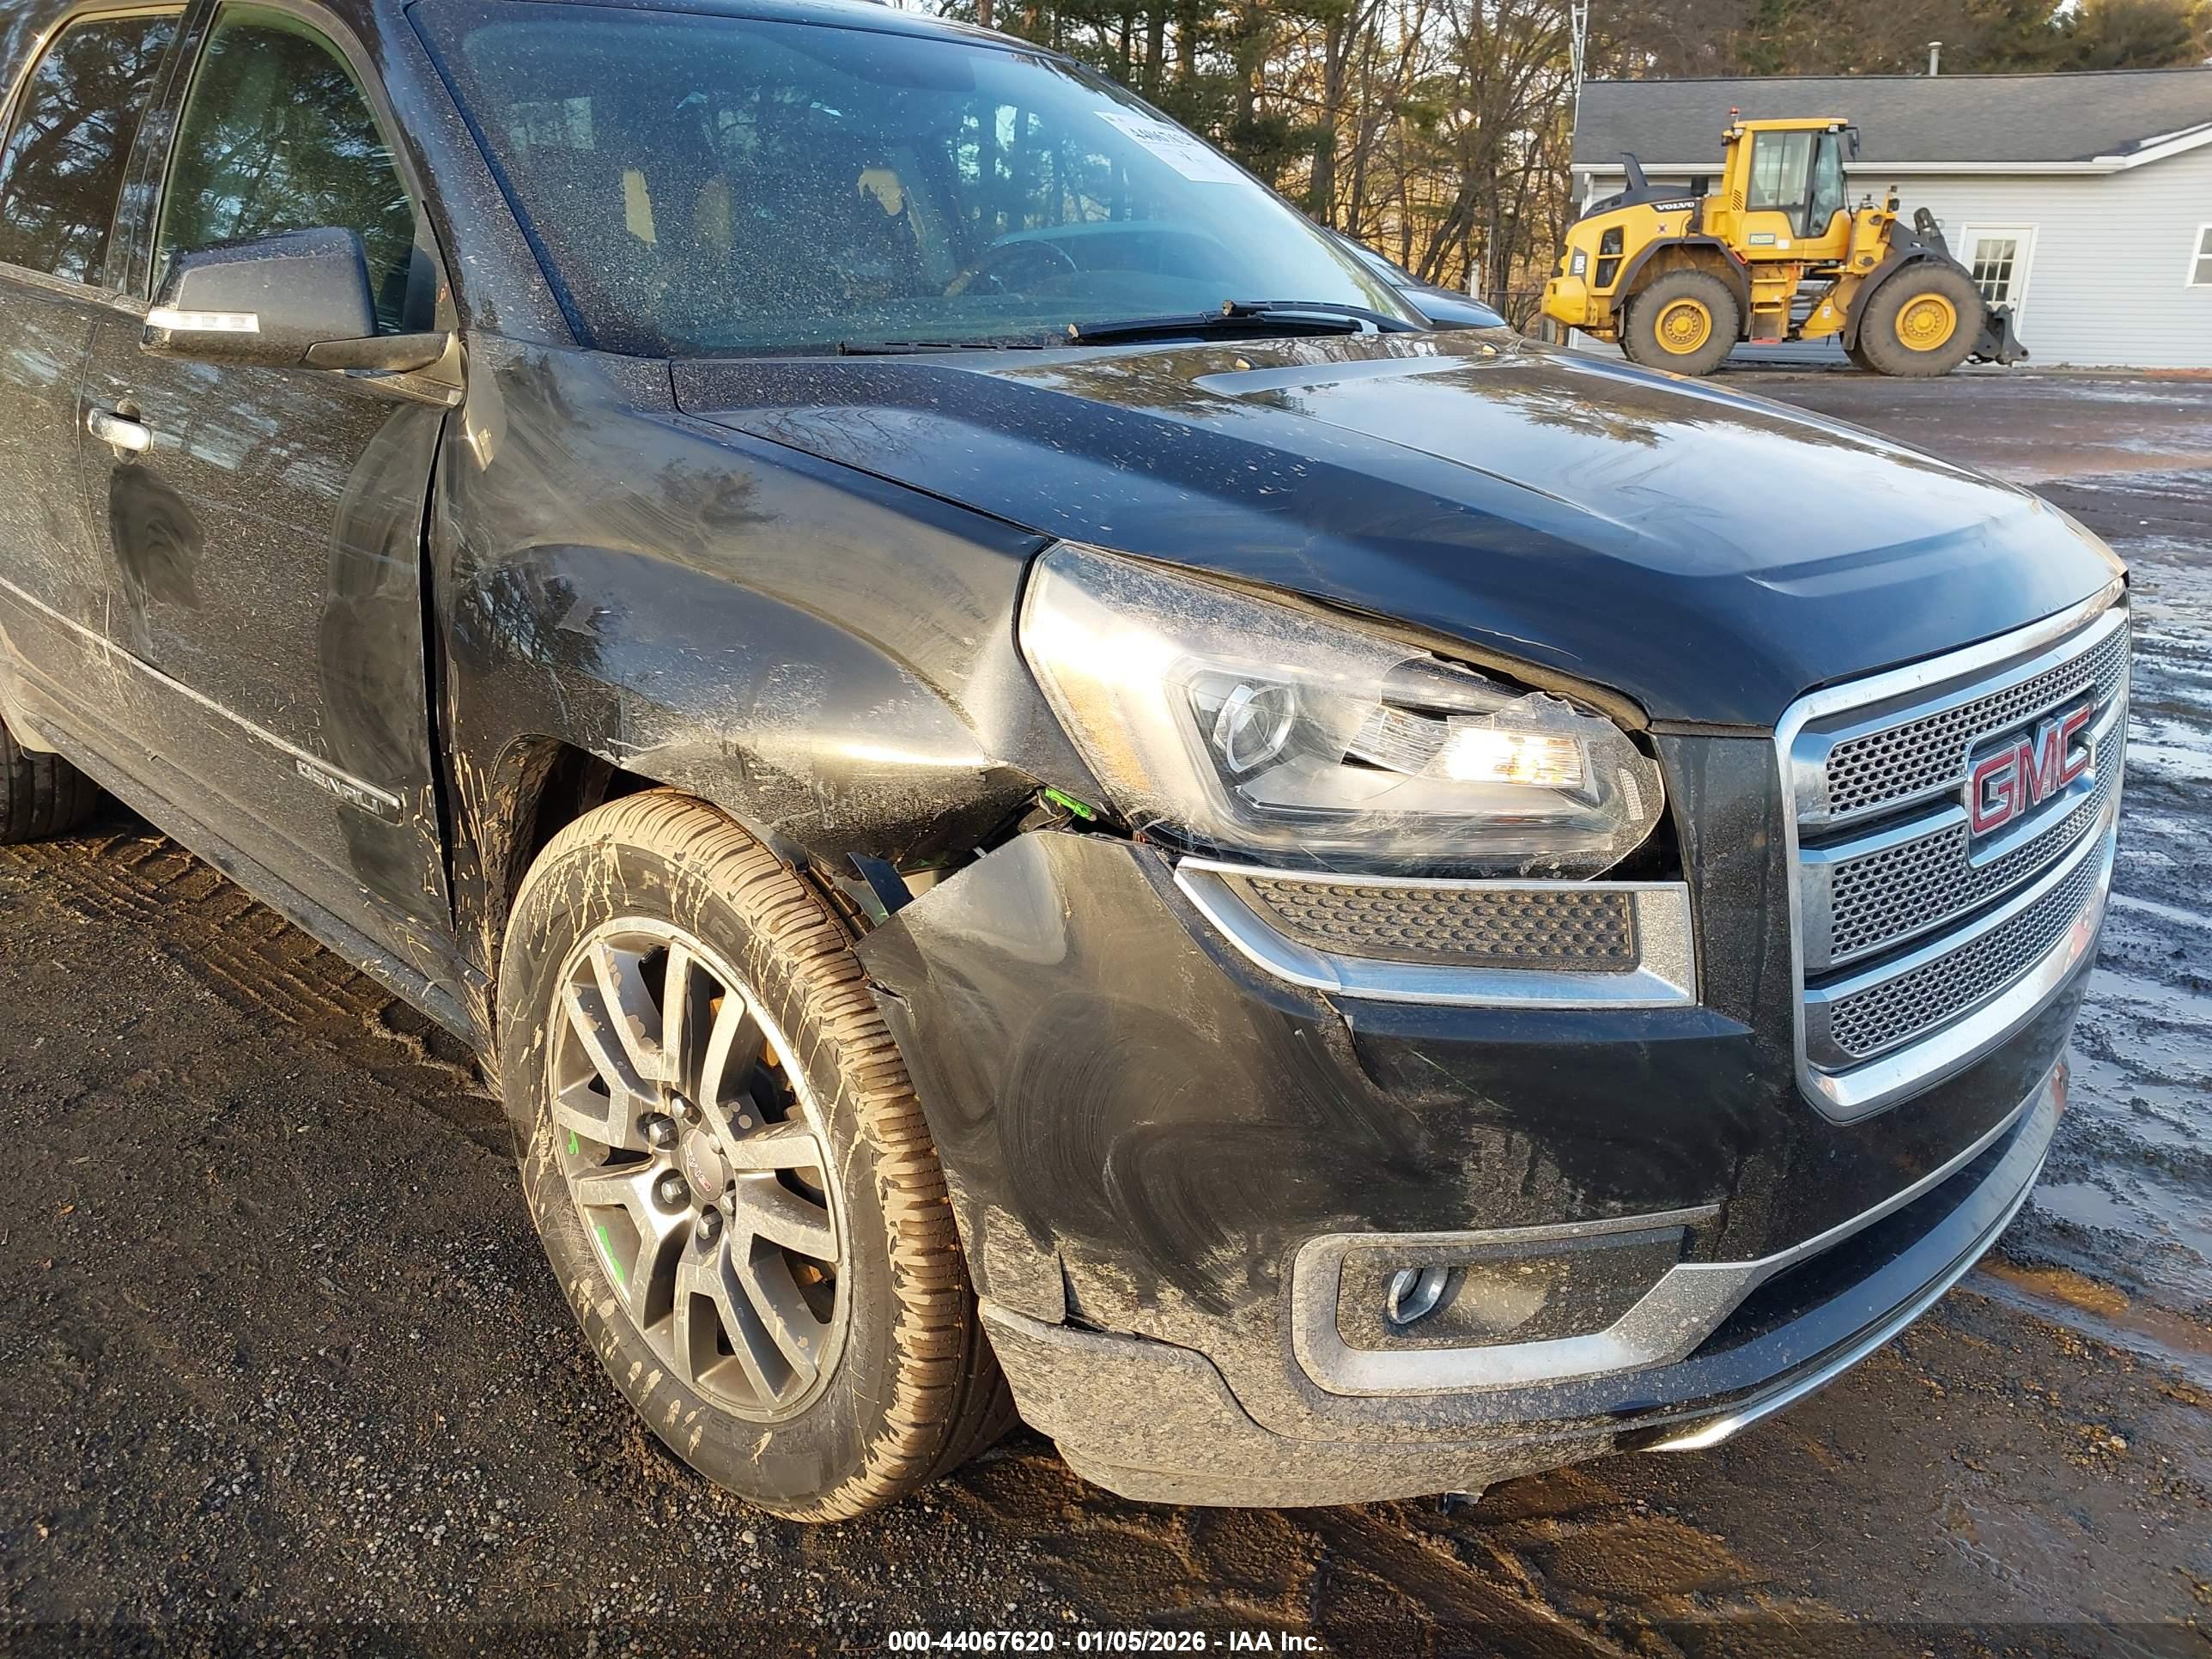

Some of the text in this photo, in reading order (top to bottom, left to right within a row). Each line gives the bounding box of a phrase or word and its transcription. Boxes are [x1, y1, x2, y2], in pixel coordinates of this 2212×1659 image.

[1656, 201, 1695, 210] VOLVO
[295, 759, 384, 816] DENALI
[1972, 703, 2090, 838] GMC
